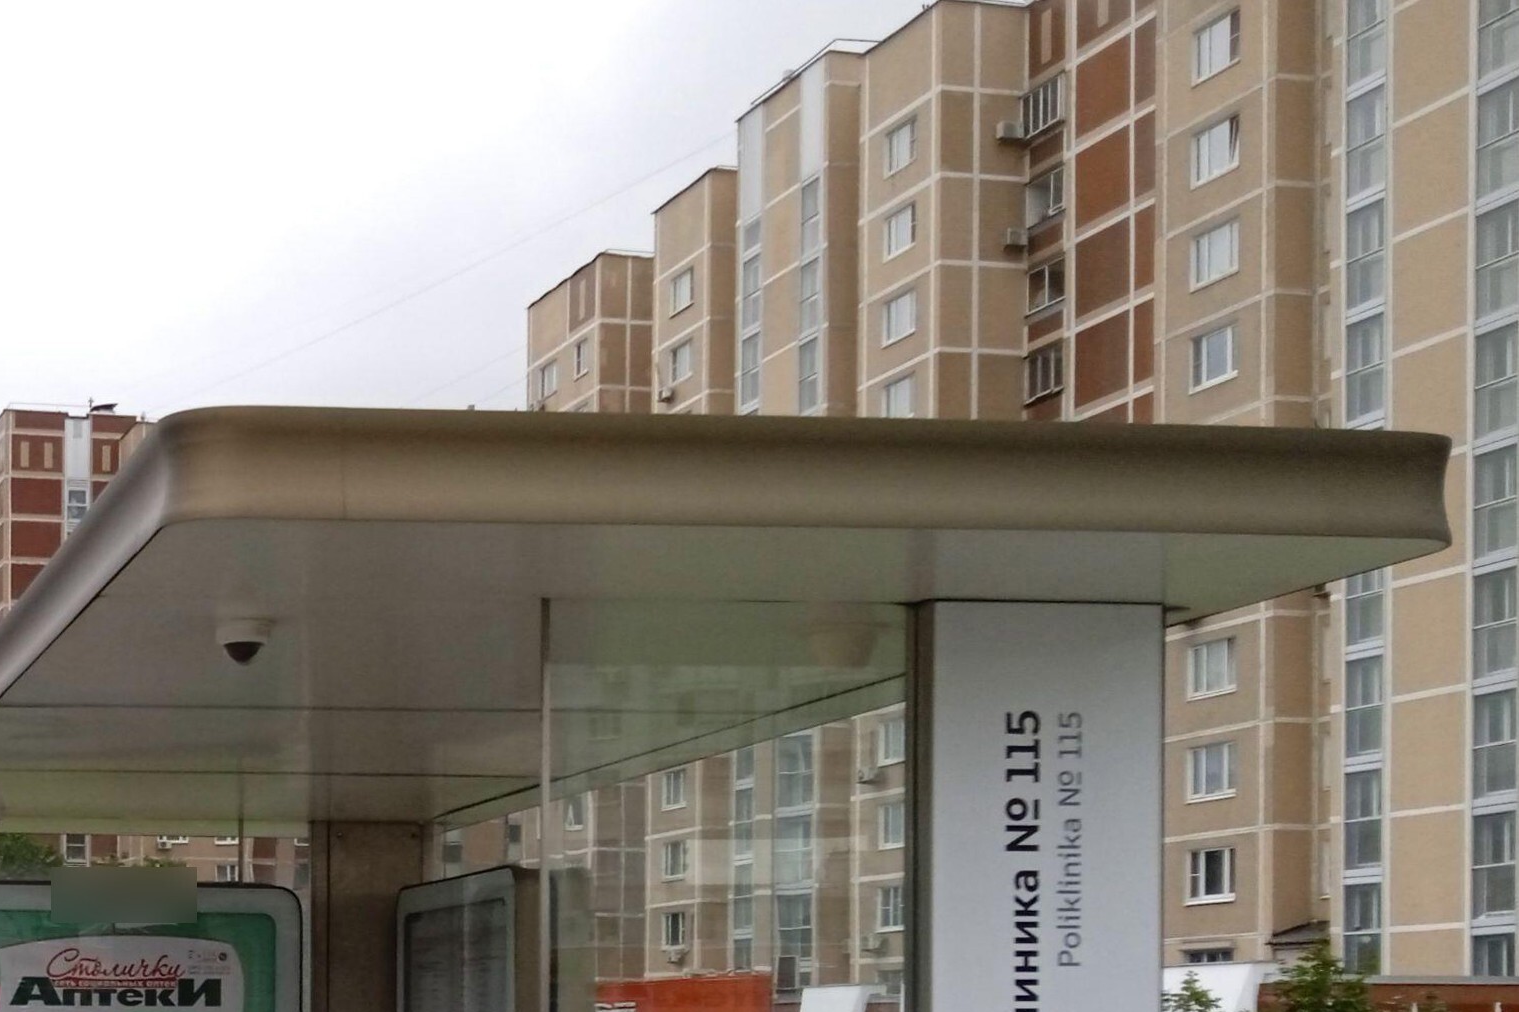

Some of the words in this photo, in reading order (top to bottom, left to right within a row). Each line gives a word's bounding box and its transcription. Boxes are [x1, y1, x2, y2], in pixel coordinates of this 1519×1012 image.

[1005, 710, 1041, 783] 115
[1057, 712, 1082, 758] 115
[1057, 770, 1082, 806] №
[1005, 798, 1041, 852] №
[1056, 818, 1082, 967] Poliklinika
[46, 948, 187, 979] Столички
